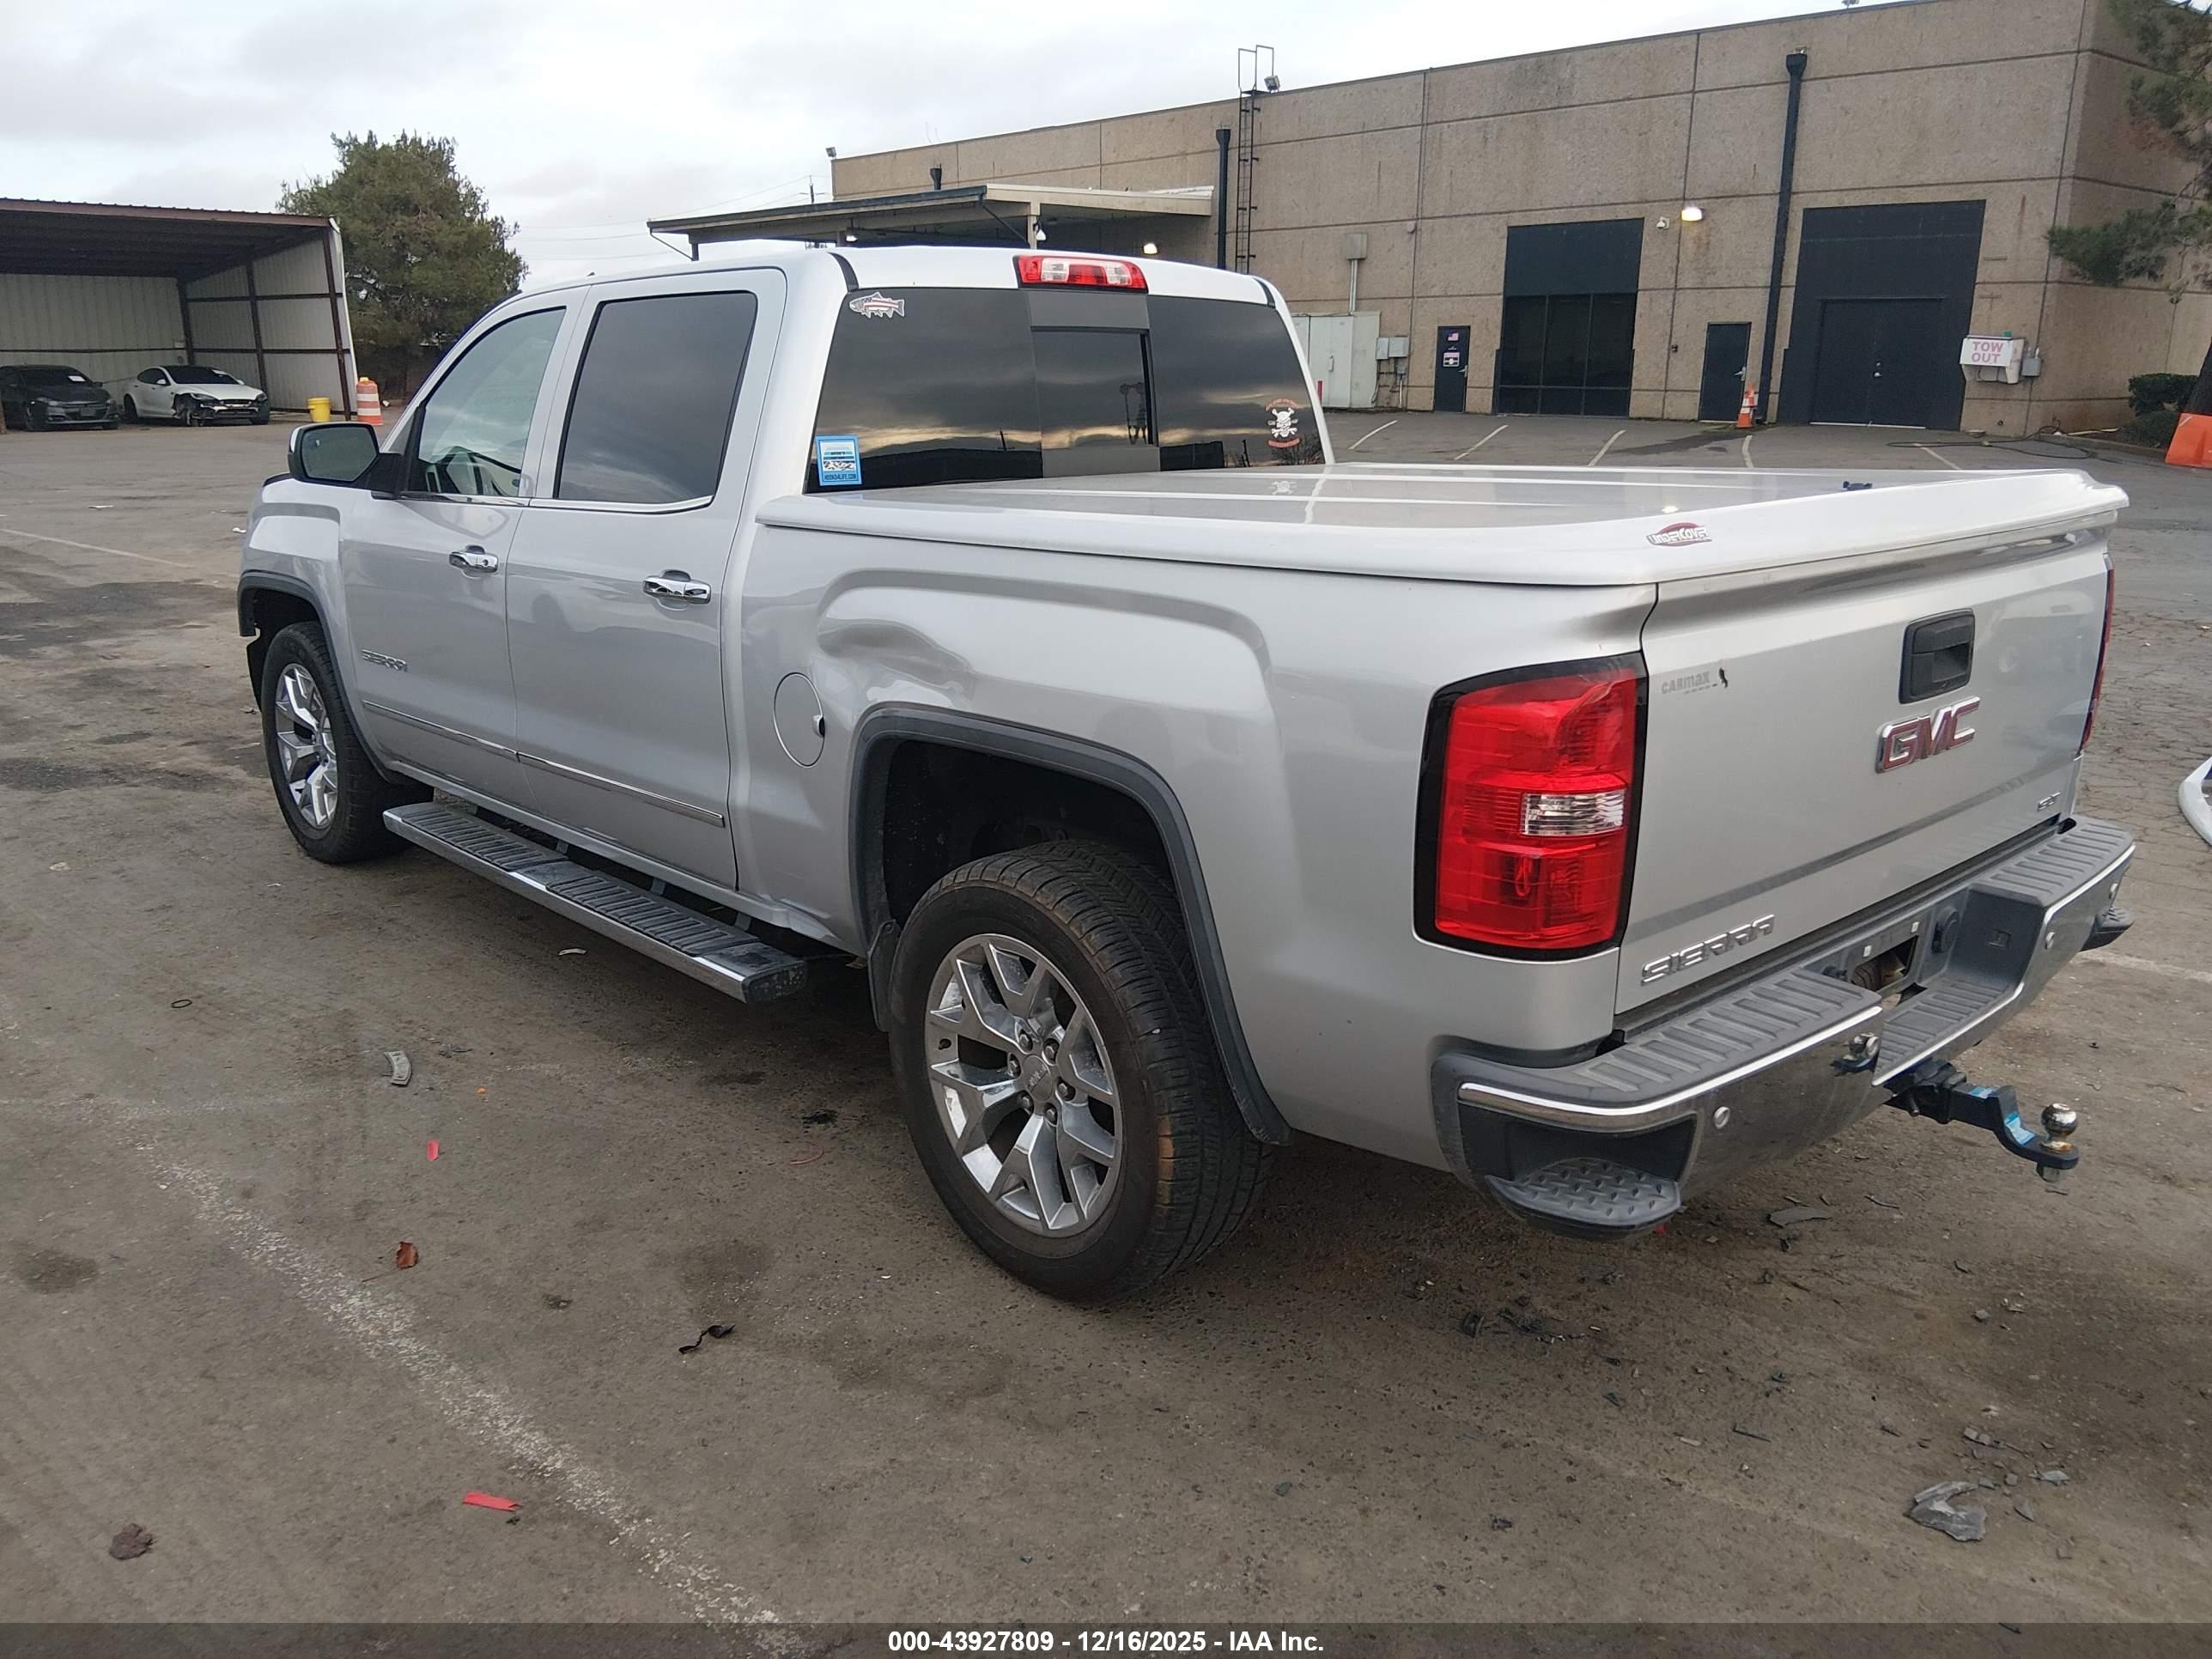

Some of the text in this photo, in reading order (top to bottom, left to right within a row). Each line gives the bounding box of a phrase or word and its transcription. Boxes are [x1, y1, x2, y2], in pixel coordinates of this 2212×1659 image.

[1972, 341, 2003, 353] TOW
[1972, 352, 2001, 364] OUT
[1875, 696, 1981, 774] GMC
[1640, 913, 1776, 987] SIERRA
